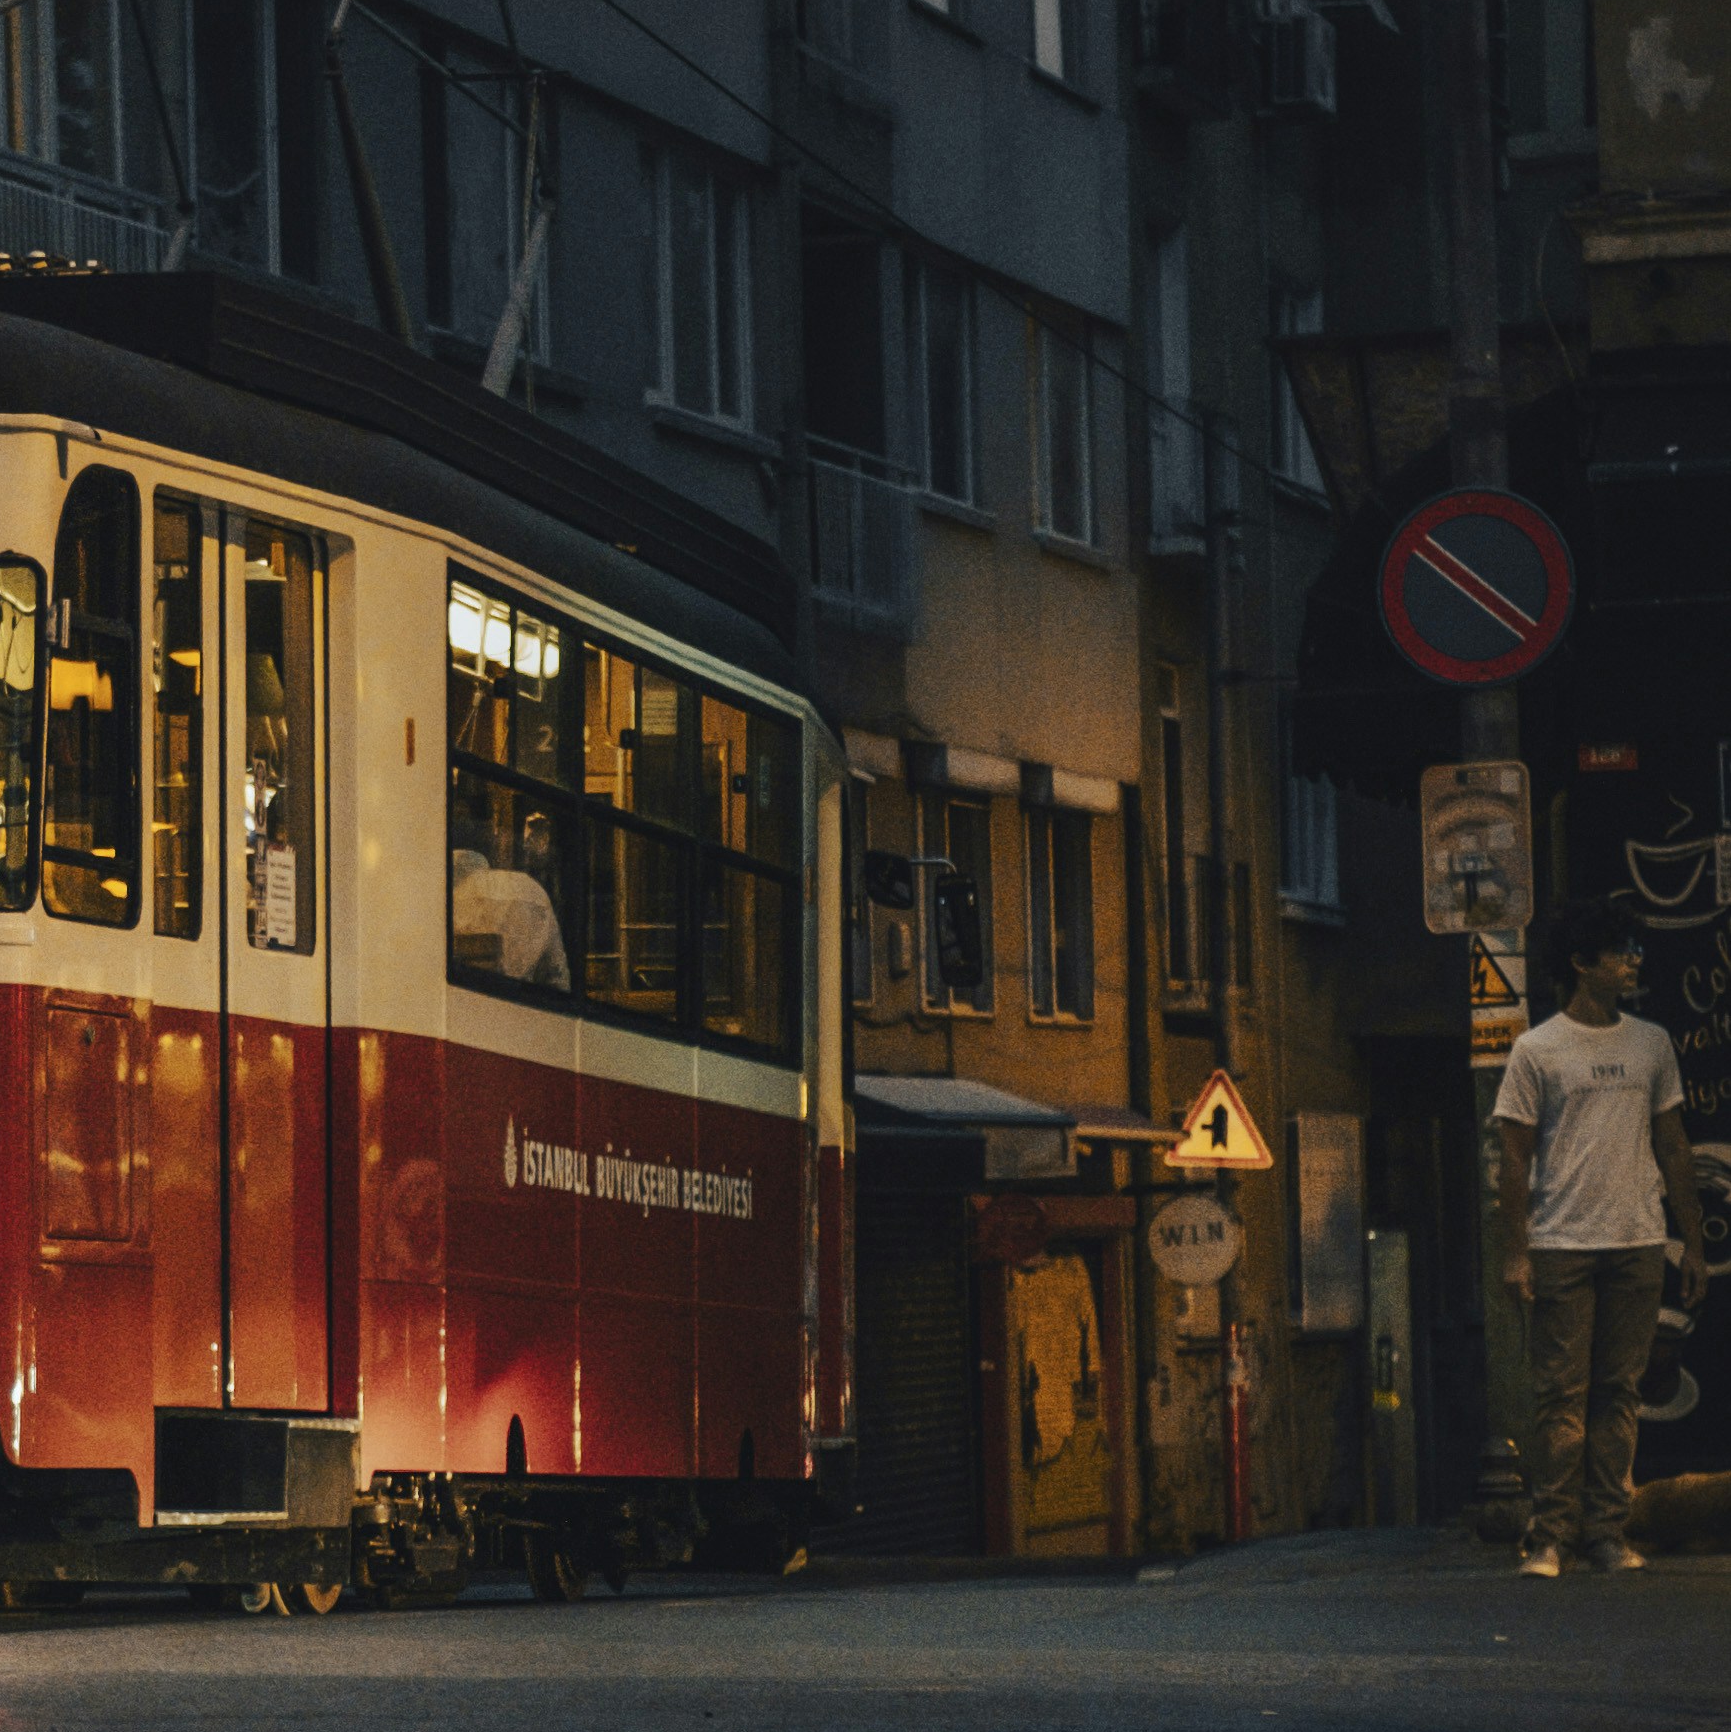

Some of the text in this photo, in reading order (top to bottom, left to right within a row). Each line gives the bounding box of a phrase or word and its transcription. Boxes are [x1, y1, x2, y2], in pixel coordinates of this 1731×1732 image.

[522, 1126, 754, 1220] İSTANBUL BÜYÜKŞEHİR BELEDİYESİ
